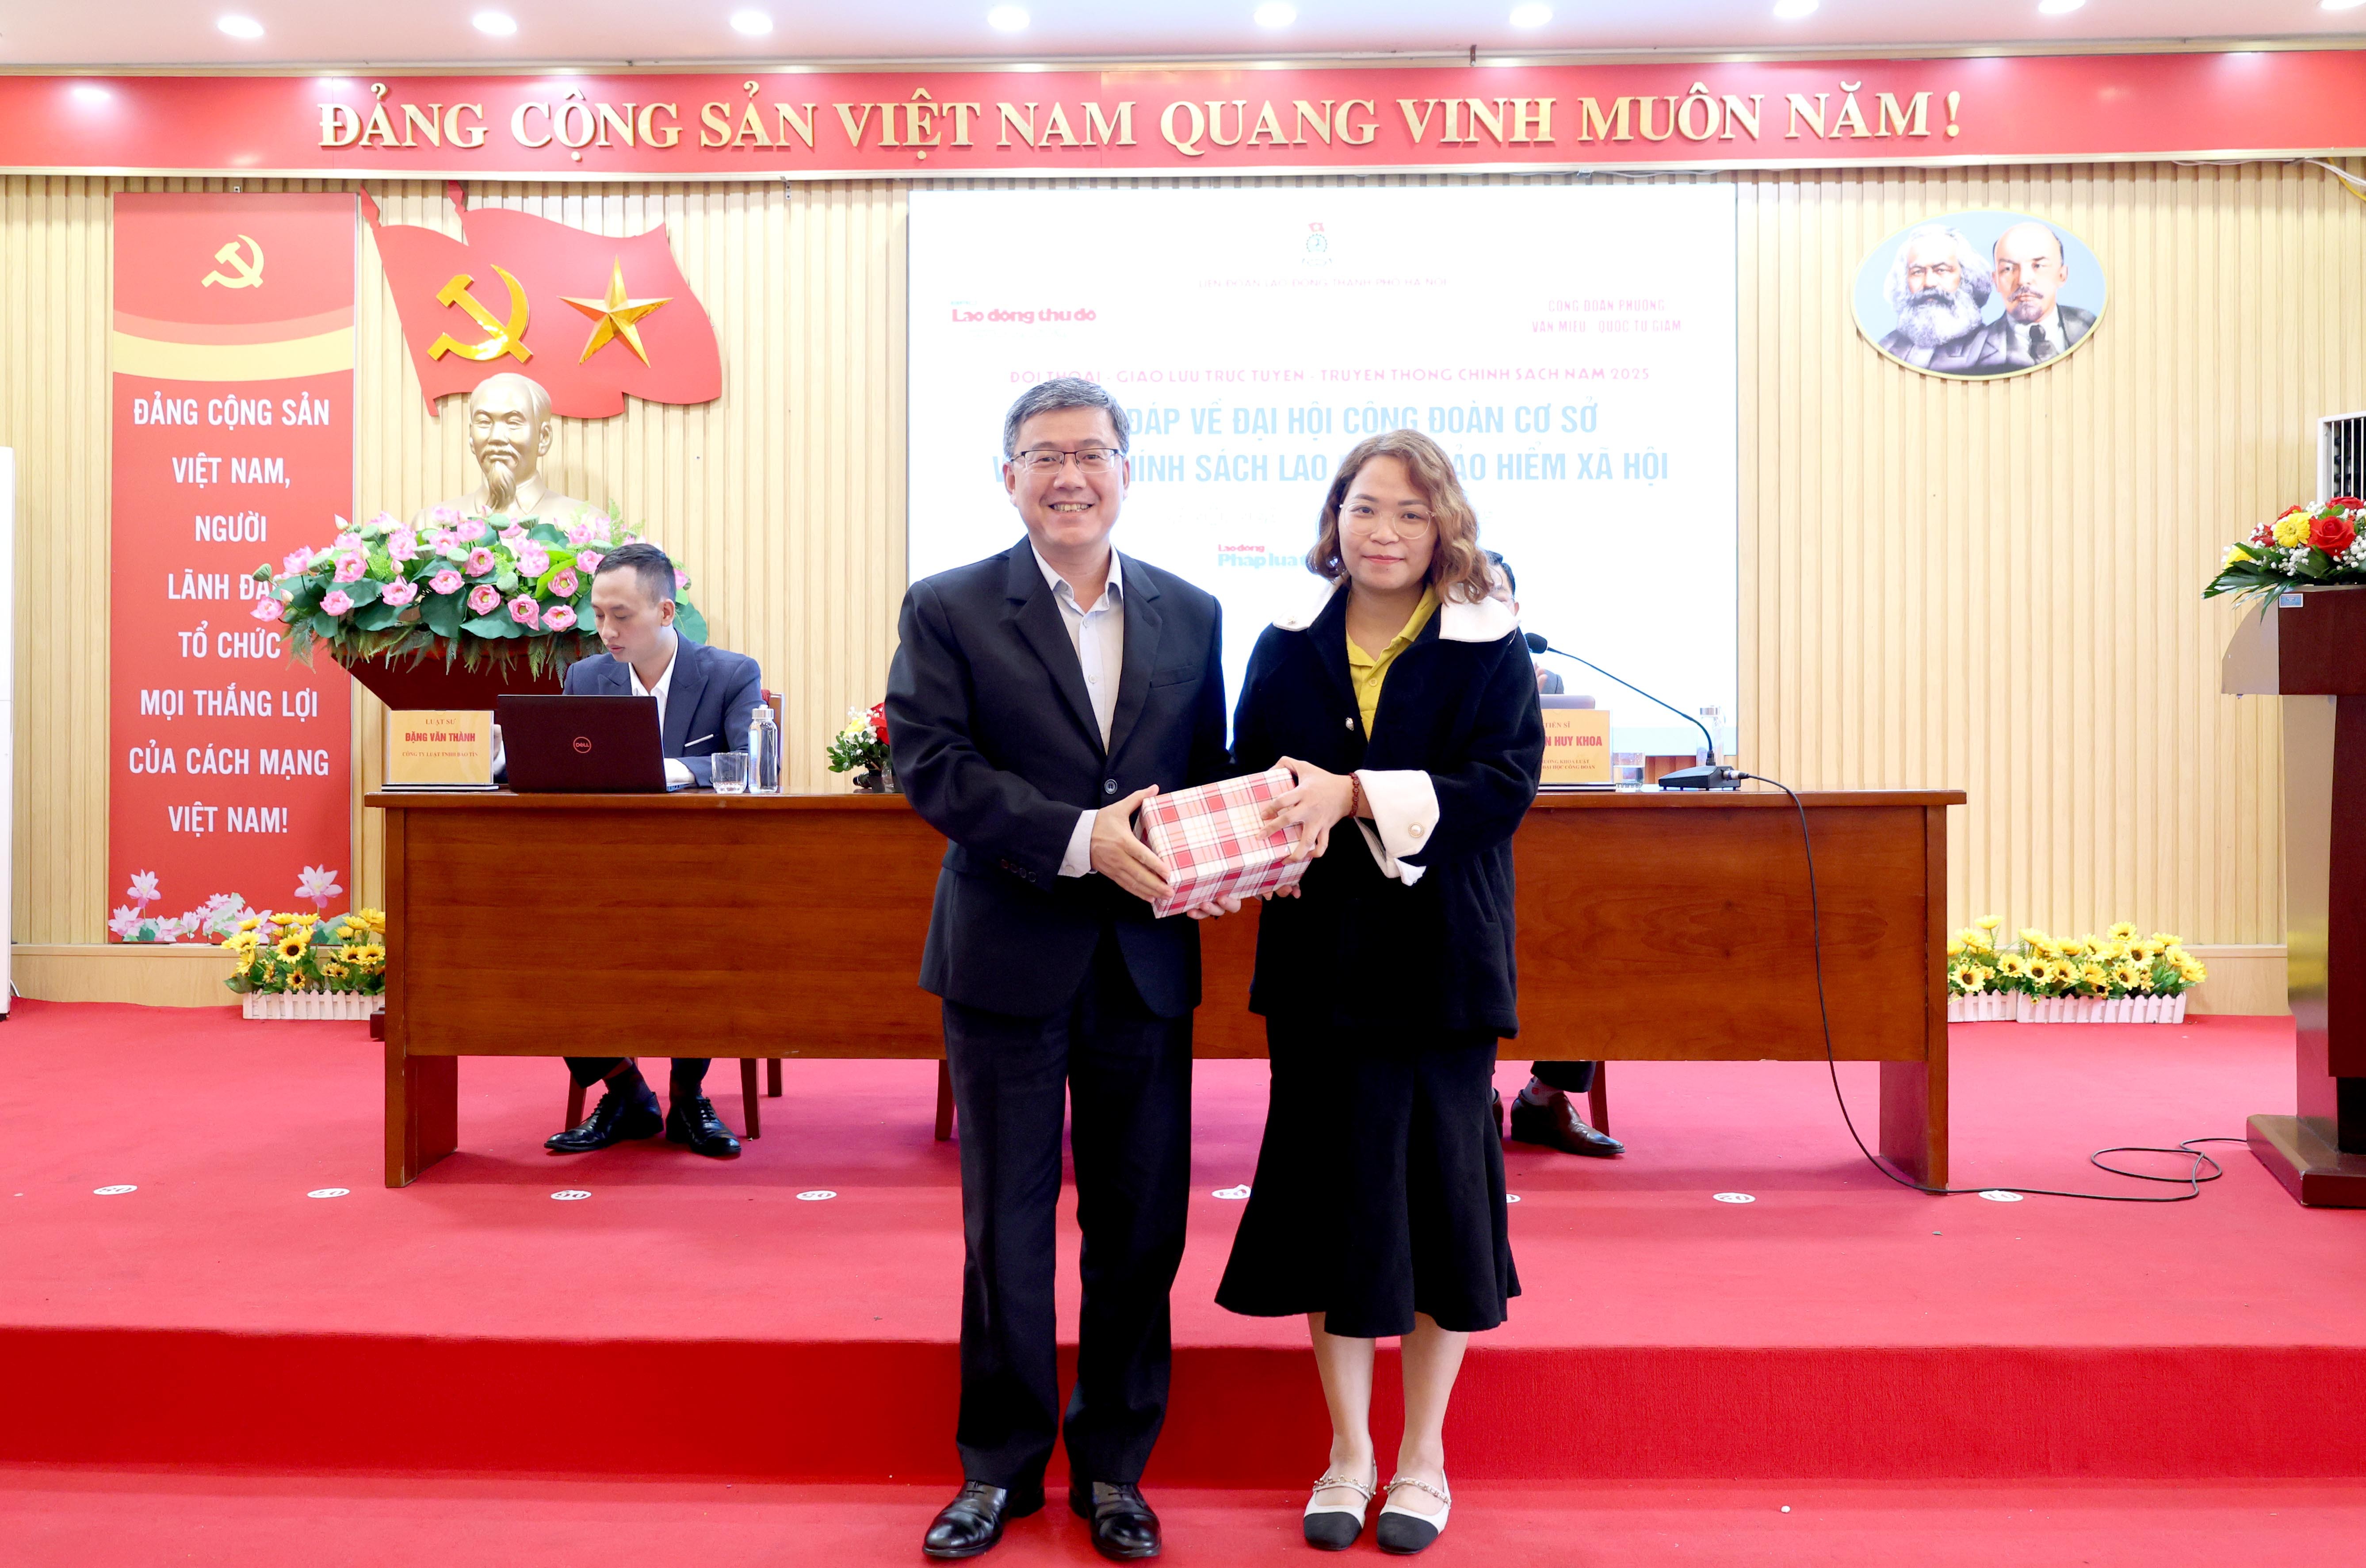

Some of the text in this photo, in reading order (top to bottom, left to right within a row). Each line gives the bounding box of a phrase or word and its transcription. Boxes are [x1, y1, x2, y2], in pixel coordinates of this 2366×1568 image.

[317, 83, 489, 148] ĐẢNG
[511, 88, 683, 161] CỘNG
[700, 80, 816, 148] SẢN
[832, 88, 980, 160] VIỆT
[997, 101, 1137, 147] NAM
[1160, 99, 1380, 156] QUANG
[1396, 98, 1557, 144] VINH
[1577, 82, 1764, 141] MUÔN
[1116, 370, 1163, 382] GIAO
[1610, 368, 1649, 379] 2025
[134, 390, 329, 430] ĐẢNG CỘNG SẢN
[1190, 398, 1222, 435] VỀ
[1232, 407, 1277, 441] ĐẠI
[1288, 401, 1332, 441] HỘI
[1343, 401, 1418, 434] CÔNG
[1428, 400, 1504, 434] ĐOÀN
[1515, 403, 1552, 434] CƠ
[1561, 396, 1598, 433] SỞ
[172, 452, 290, 489] VIỆT NAM,
[1195, 448, 1268, 482] SÁCH
[1279, 454, 1327, 482] LAO
[1455, 444, 1486, 481] ẢO
[1497, 441, 1566, 481] HIỂM
[1577, 447, 1613, 480] XÃ
[1624, 447, 1668, 486] HỘI
[195, 510, 267, 542] NGƯỜI
[168, 568, 229, 600] LÃNH
[178, 620, 281, 658] TỔ CHỨC
[141, 682, 317, 722] MỌI THẮNG LỢI
[405, 731, 475, 743] ĐẶNG VĂN THÀNH
[1554, 736, 1573, 746] HUY
[1576, 736, 1602, 746] KHOA
[129, 739, 329, 780] CỦA CÁCH MẠNG
[168, 801, 287, 837] VIỆT NAM!
